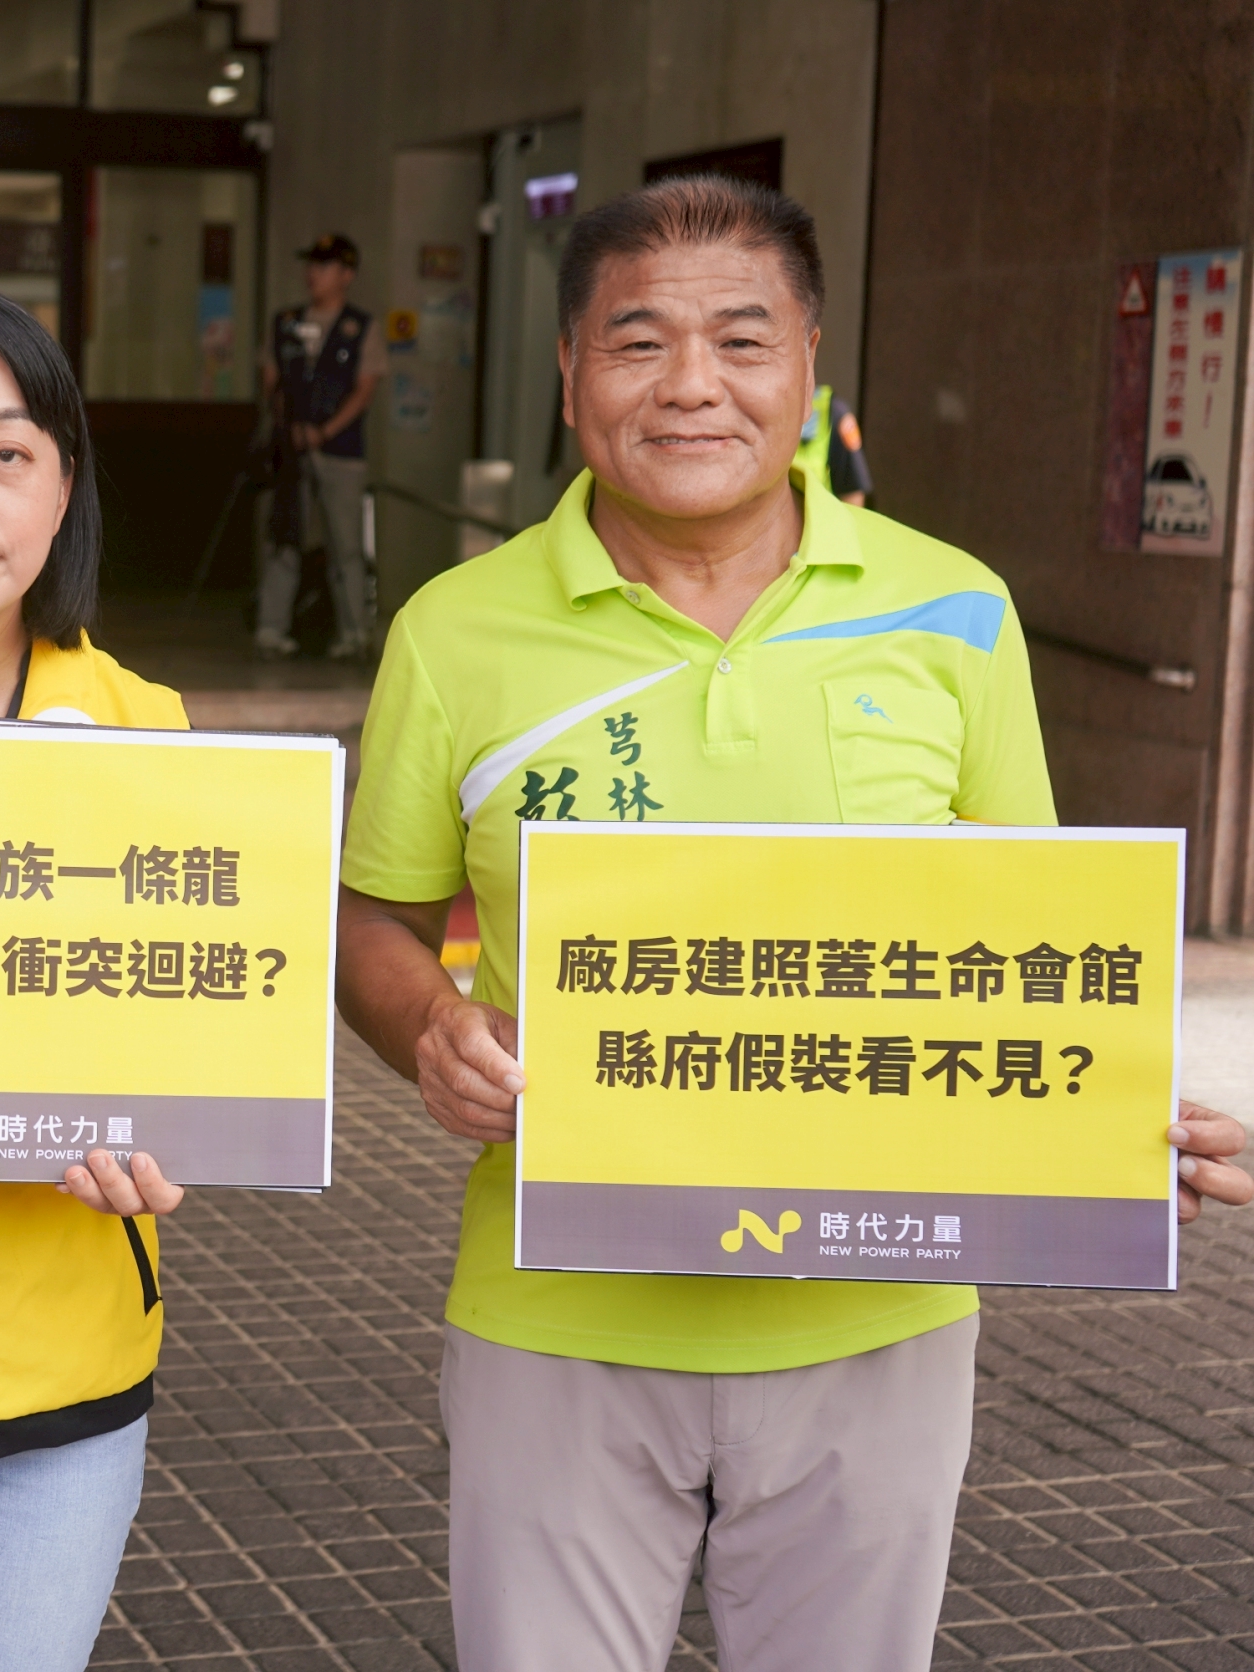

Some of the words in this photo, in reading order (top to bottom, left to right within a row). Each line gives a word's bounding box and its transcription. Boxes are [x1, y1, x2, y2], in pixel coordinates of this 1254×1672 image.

[603, 712, 665, 821] 芎林
[556, 933, 1143, 1006] 廠房建照蓋生命會館
[596, 1029, 1094, 1098] 縣府假裝看不見？
[35, 1149, 84, 1160] POWER
[819, 1211, 962, 1243] 時代力量
[819, 1245, 852, 1256] NEW
[858, 1246, 910, 1258] POWER
[916, 1248, 961, 1260] PARTY
